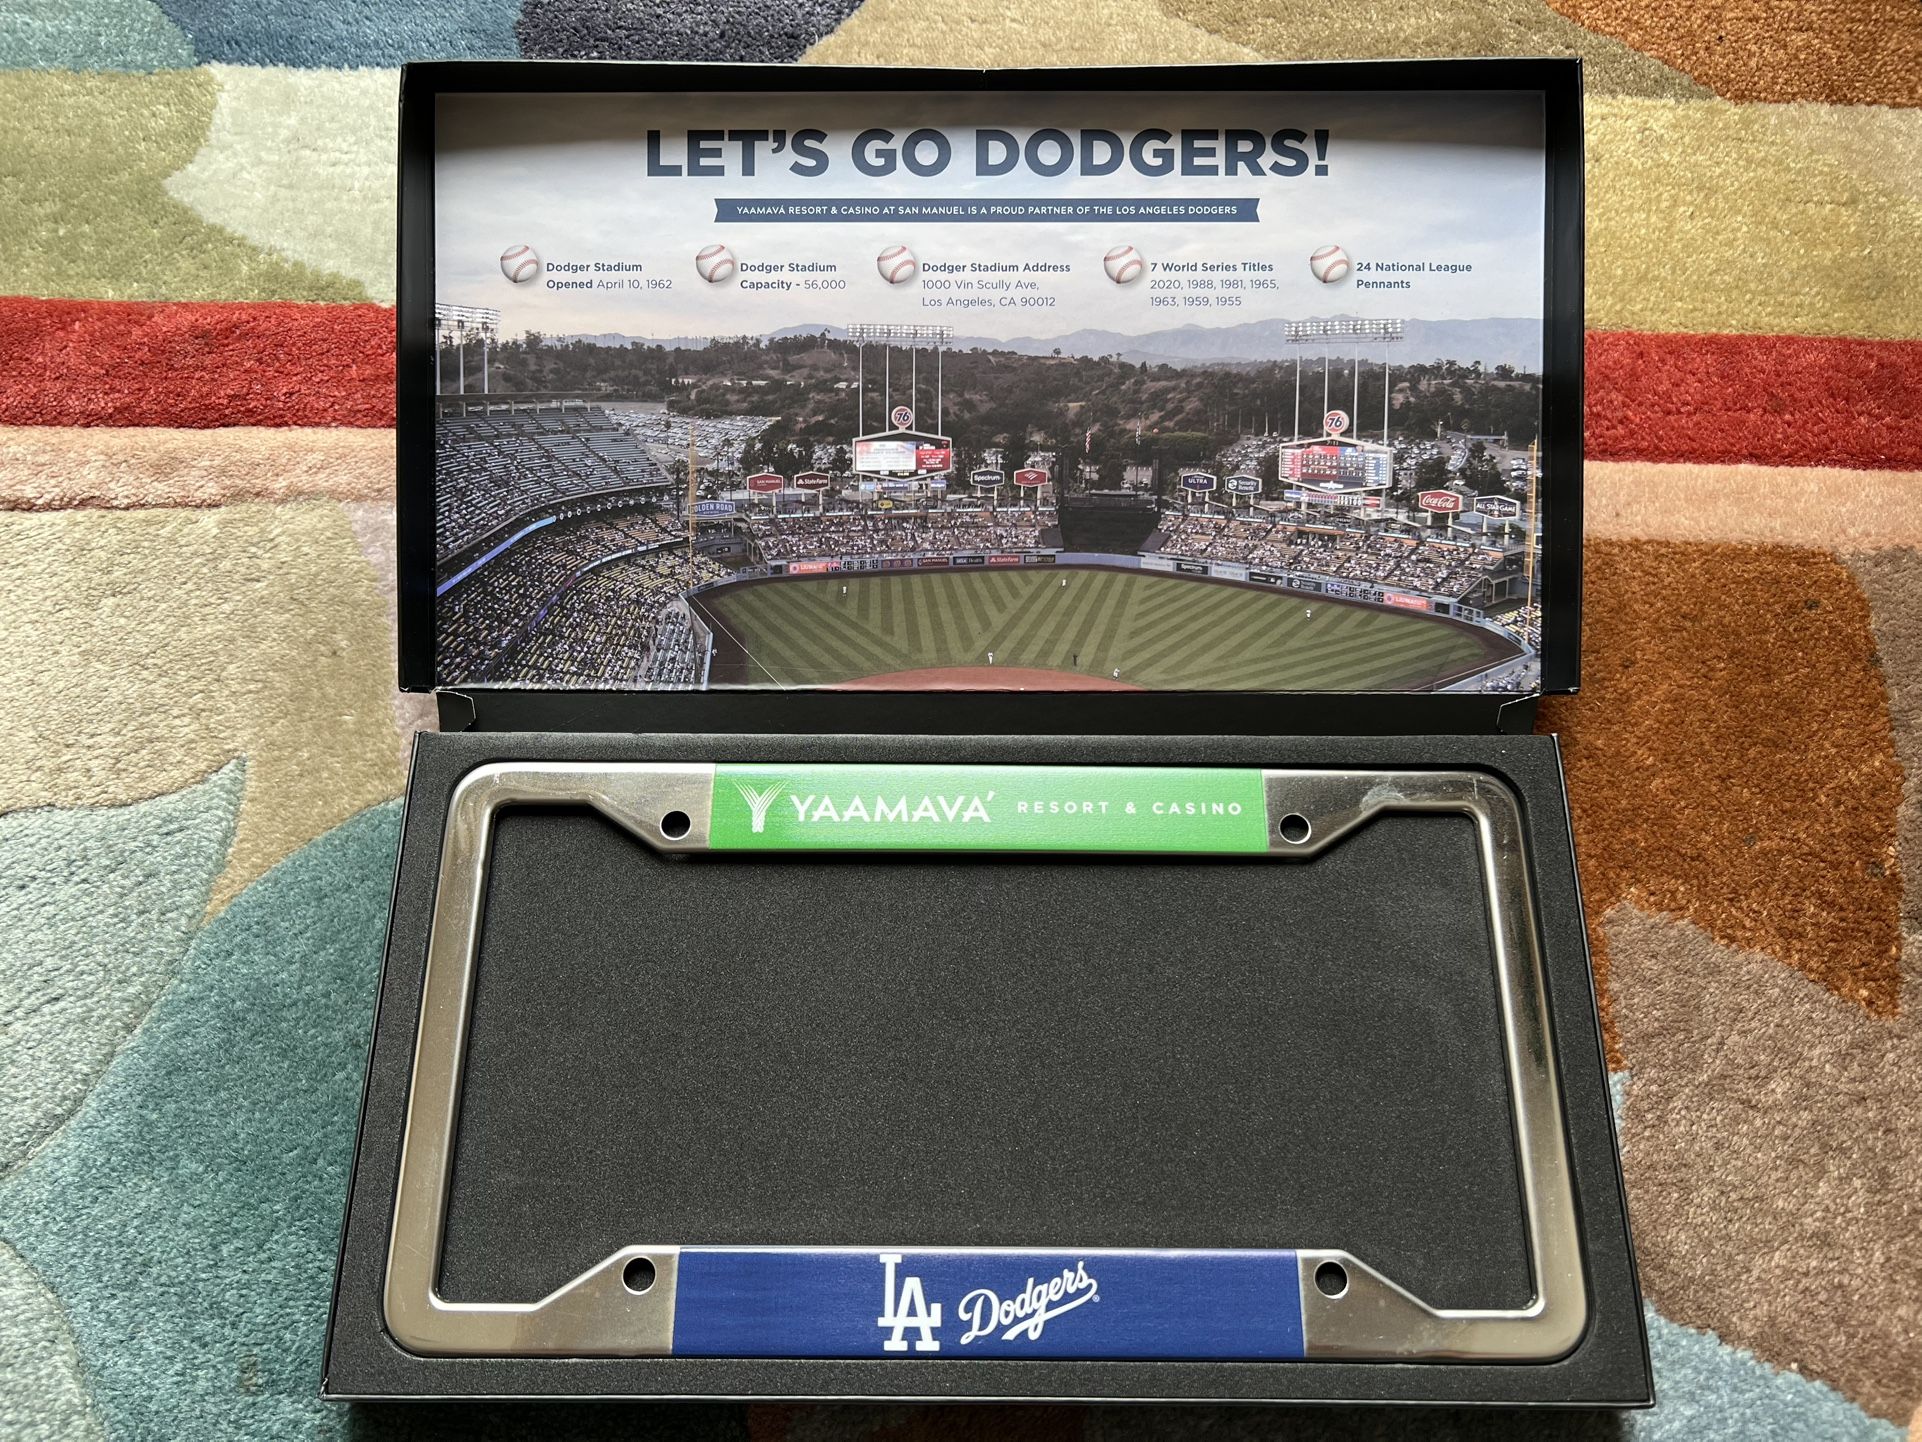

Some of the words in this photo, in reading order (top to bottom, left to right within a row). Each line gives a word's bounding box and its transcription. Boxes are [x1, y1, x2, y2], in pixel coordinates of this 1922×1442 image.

[645, 128, 830, 178] LET’S
[850, 128, 953, 178] GO
[974, 128, 1331, 178] DODGERS!
[736, 204, 786, 216] YAAMAVÁ
[788, 205, 828, 216] RESORT
[830, 205, 838, 216] &
[840, 205, 880, 216] CASINO
[882, 205, 896, 216] AT
[898, 205, 919, 216] SAN
[921, 205, 966, 216] MANUEL
[967, 205, 978, 216] IS
[979, 205, 988, 216] A
[990, 205, 1025, 216] PROUD
[1028, 205, 1074, 216] PARTNER
[1076, 205, 1091, 216] OF
[1093, 205, 1113, 216] THE
[1116, 205, 1136, 216] LOS
[1138, 205, 1186, 216] ANGELES
[1188, 205, 1238, 216] DODGERS
[546, 262, 591, 274] Dodger
[593, 261, 643, 273] Stadium
[739, 262, 785, 274] Dodger
[787, 261, 837, 273] Stadium
[922, 262, 968, 274] Dodger
[969, 261, 1019, 273] Stadium
[1022, 261, 1071, 273] Address
[1150, 262, 1159, 273] 7
[1160, 262, 1198, 273] World
[1201, 262, 1238, 273] Series
[1240, 262, 1274, 273] Titles
[1356, 262, 1372, 272] 24
[1375, 261, 1426, 272] National
[1428, 262, 1473, 274] League
[546, 279, 593, 292] Opened
[596, 279, 624, 292] April
[627, 280, 643, 292] 10,
[646, 280, 673, 290] 1962
[739, 279, 793, 292] Capacity
[803, 280, 847, 291] 56,000
[922, 280, 952, 290] 1000
[954, 279, 974, 290] Vin
[976, 279, 1012, 292] Scully
[1014, 279, 1040, 292] Ave,
[1150, 279, 1184, 291] 2020,
[1186, 279, 1217, 291] 1988,
[1219, 279, 1247, 291] 1981,
[1249, 279, 1280, 291] 1965,
[1356, 279, 1412, 289] Pennants
[922, 296, 943, 307] Los
[945, 296, 996, 309] Angeles,
[998, 296, 1017, 307] CA
[1020, 296, 1056, 307] 90012
[1150, 296, 1180, 308] 1963,
[1182, 296, 1212, 308] 1959,
[1215, 296, 1242, 307] 1955
[896, 411, 910, 422] 76
[1328, 416, 1343, 428] 76
[974, 474, 1001, 482] Spectrum
[1238, 479, 1257, 487] Security
[716, 502, 733, 512] ROAD
[1500, 504, 1516, 512] GAME
[1016, 800, 1110, 814] RESORT
[1124, 801, 1137, 814] &
[1152, 801, 1244, 816] CASINO
[877, 1253, 942, 1351] LA
[957, 1260, 1099, 1345] Dodgers
